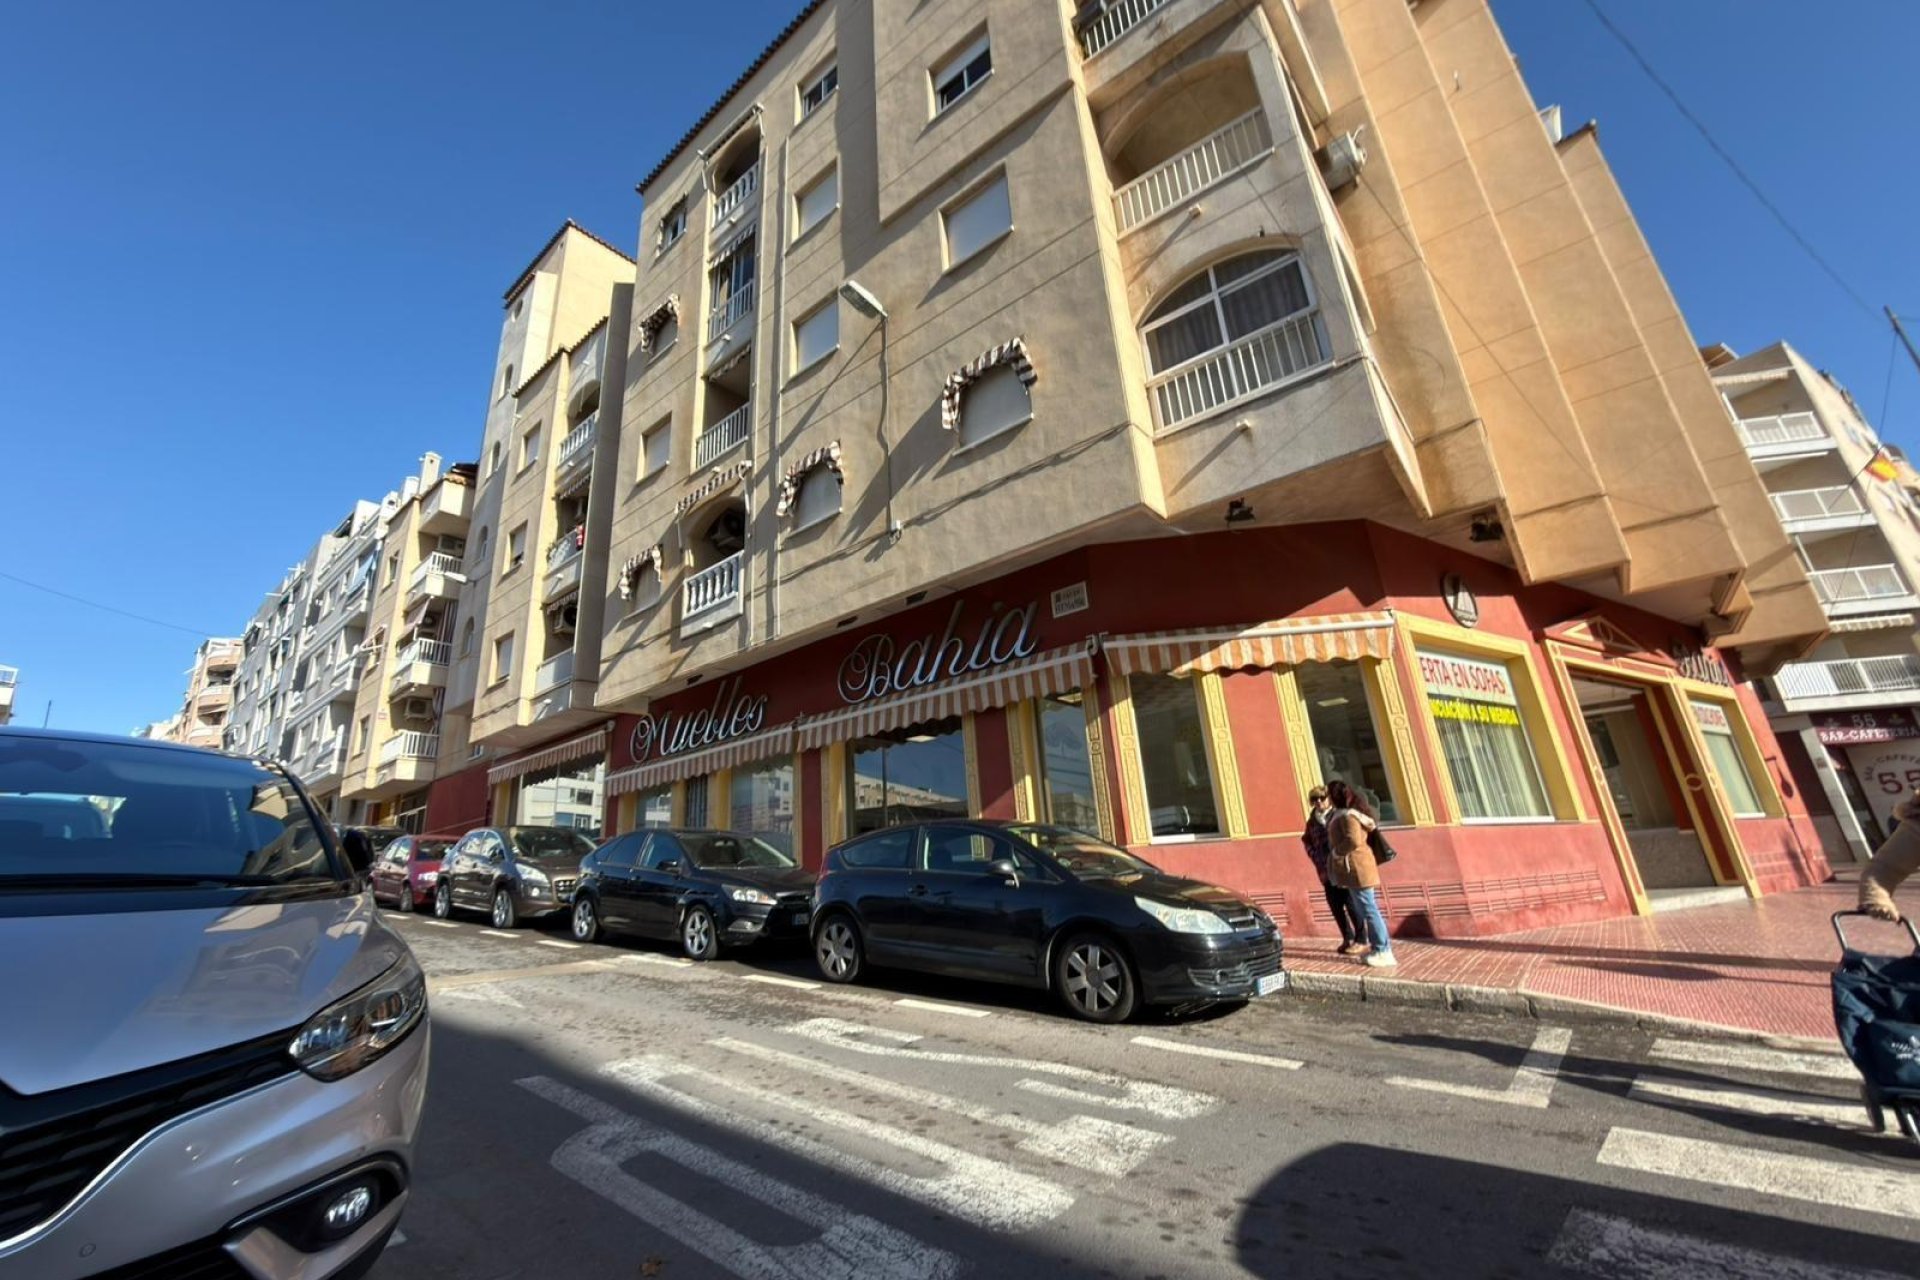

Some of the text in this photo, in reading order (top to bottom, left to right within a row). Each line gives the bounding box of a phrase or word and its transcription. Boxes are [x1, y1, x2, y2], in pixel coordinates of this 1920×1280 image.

[1451, 662, 1471, 689] EN
[1469, 665, 1506, 694] SOFAS
[630, 676, 767, 763] Muebles
